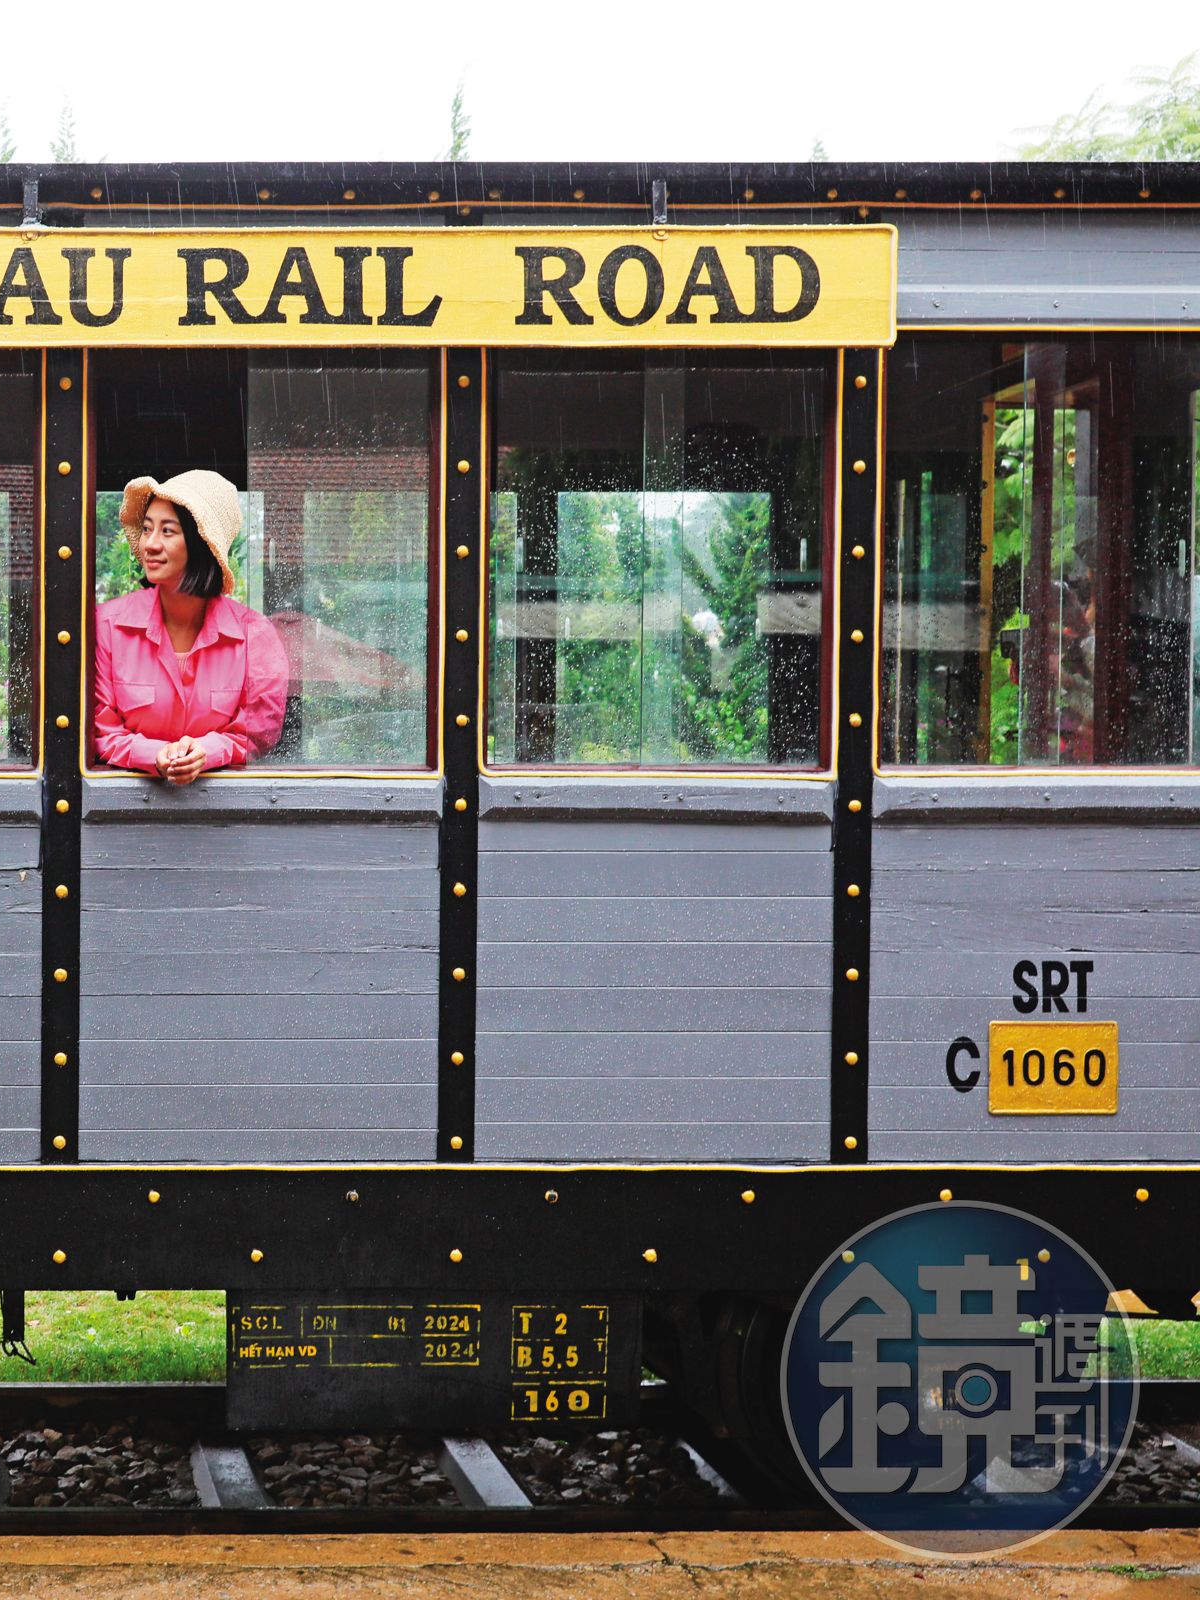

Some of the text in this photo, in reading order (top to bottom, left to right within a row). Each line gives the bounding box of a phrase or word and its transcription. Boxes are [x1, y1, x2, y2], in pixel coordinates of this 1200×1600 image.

[177, 246, 443, 327] RAIL
[515, 245, 821, 327] ROAD
[1012, 959, 1094, 1014] SRT
[946, 1036, 1106, 1093] C 1060
[240, 1315, 283, 1331] SCL
[424, 1314, 470, 1333] 2024
[519, 1312, 533, 1335] T
[554, 1312, 568, 1336] 2
[297, 1344, 319, 1358] VD
[424, 1341, 475, 1359] 2024
[517, 1345, 533, 1368] B
[525, 1389, 590, 1413] 160
